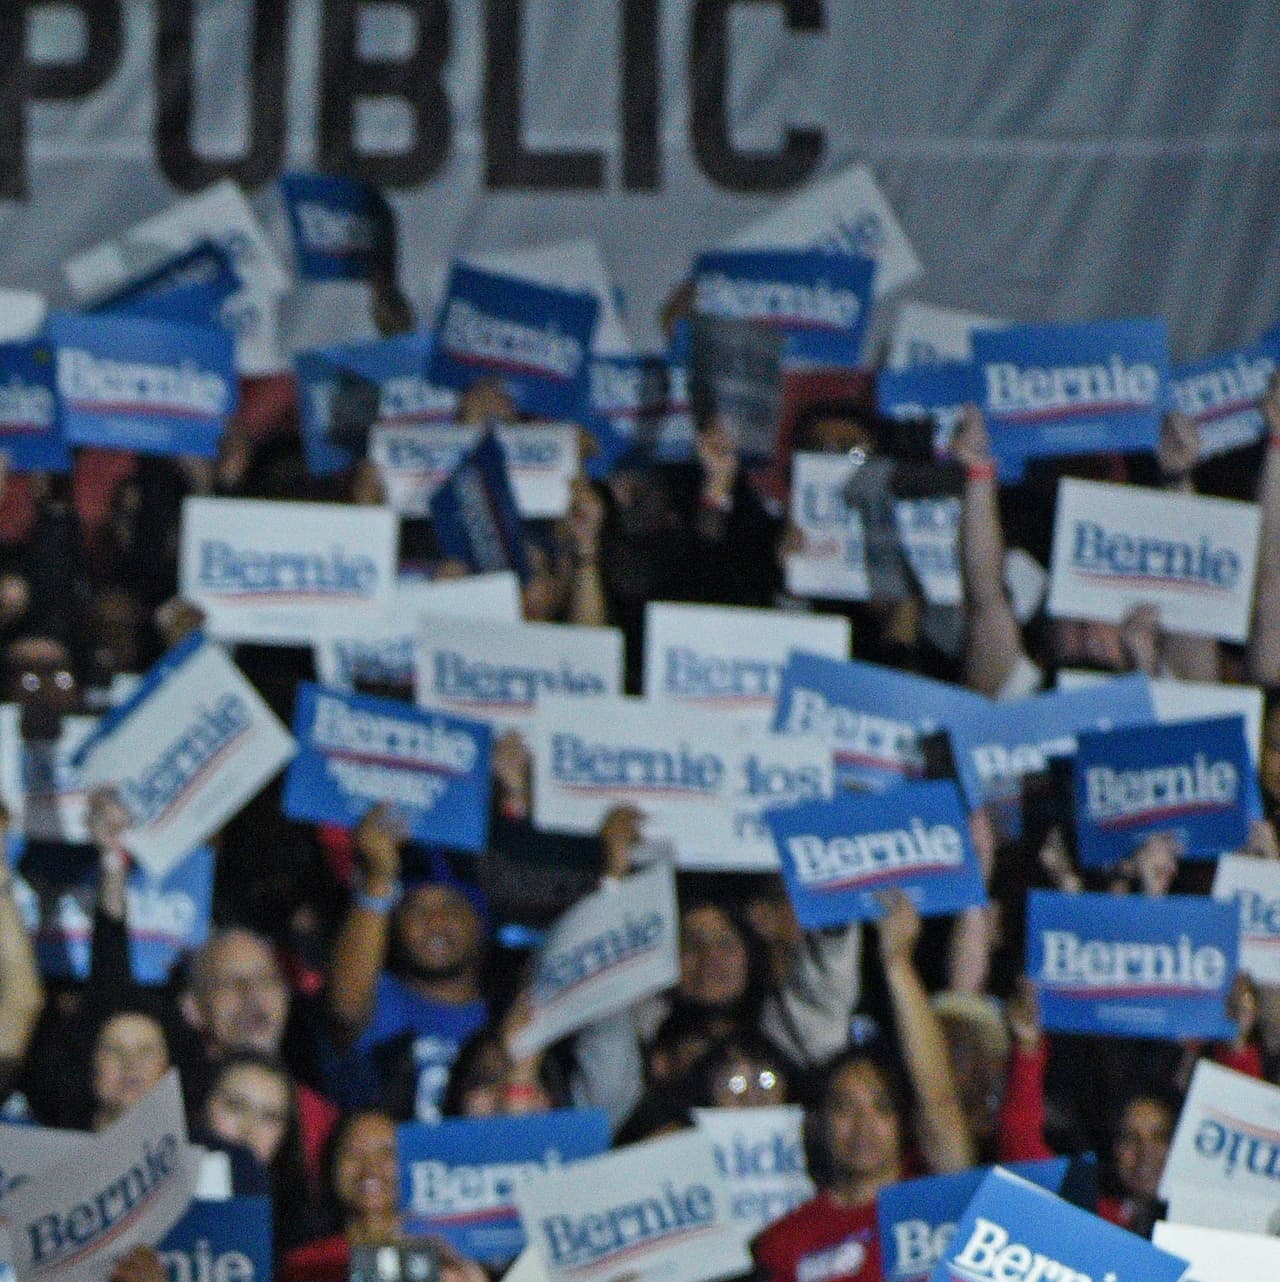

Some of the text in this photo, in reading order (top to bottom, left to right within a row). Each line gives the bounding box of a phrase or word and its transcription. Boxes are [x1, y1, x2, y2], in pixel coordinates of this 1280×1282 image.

[55, 343, 228, 420] Bernie
[983, 354, 1160, 415] Bernie
[199, 540, 379, 592] Bernie
[1070, 519, 1241, 588] Bernie
[312, 692, 478, 768] Bernie
[550, 731, 726, 790] Bernie
[1085, 751, 1237, 818] Bernie
[788, 815, 965, 888] Bernie
[1042, 927, 1228, 990] Bernie
[24, 1128, 181, 1264] Bernie
[544, 1177, 715, 1266] Bernie
